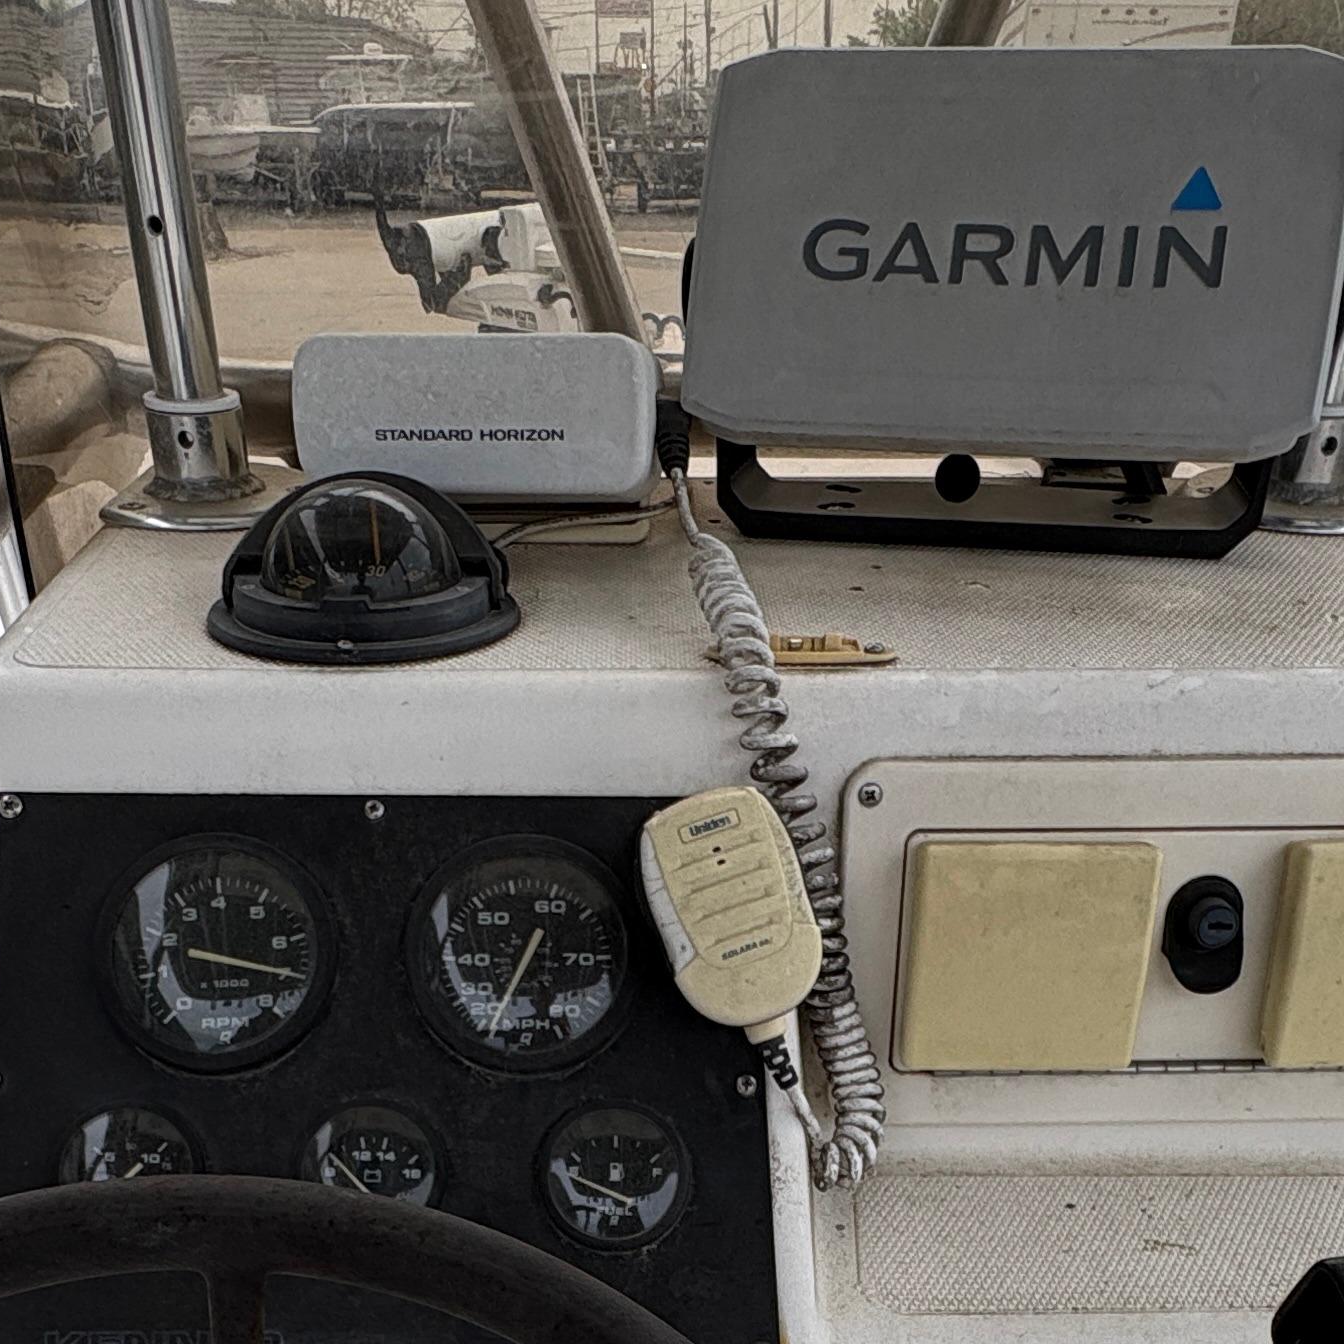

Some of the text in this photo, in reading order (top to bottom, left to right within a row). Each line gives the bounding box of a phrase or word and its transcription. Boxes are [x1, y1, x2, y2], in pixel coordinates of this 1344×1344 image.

[802, 217, 1228, 289] GARMIN
[374, 428, 565, 442] STANDARD HORIZON
[366, 565, 386, 577] 30
[210, 896, 227, 910] 4
[534, 900, 567, 915] 60
[182, 908, 198, 922] 3
[249, 905, 266, 920] 5
[477, 911, 510, 925] 50
[162, 932, 178, 947] 2
[272, 936, 288, 950] 6
[457, 953, 491, 967] 40
[562, 952, 595, 966] 70
[201, 1016, 251, 1029] RPM
[141, 1153, 161, 1164] 10
